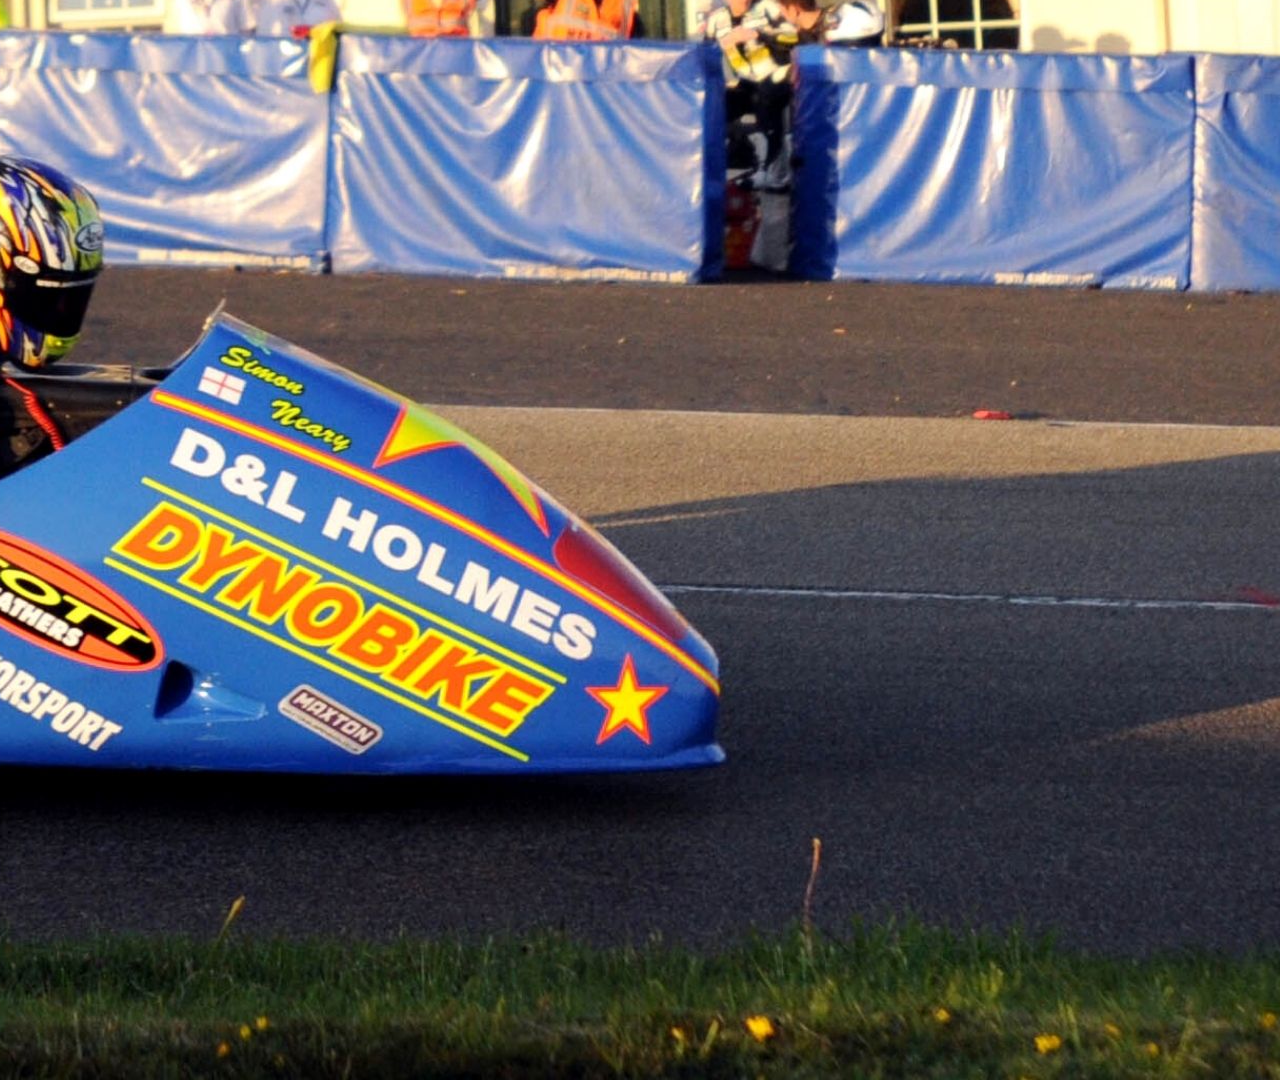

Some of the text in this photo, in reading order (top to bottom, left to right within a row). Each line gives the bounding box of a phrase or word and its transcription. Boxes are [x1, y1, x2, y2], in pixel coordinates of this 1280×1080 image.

[220, 346, 304, 395] Simon
[271, 398, 352, 453] Neary
[169, 427, 597, 660] D&L HOLMES
[111, 500, 557, 738] DYNOBIKE
[292, 692, 375, 743] MAXTON
